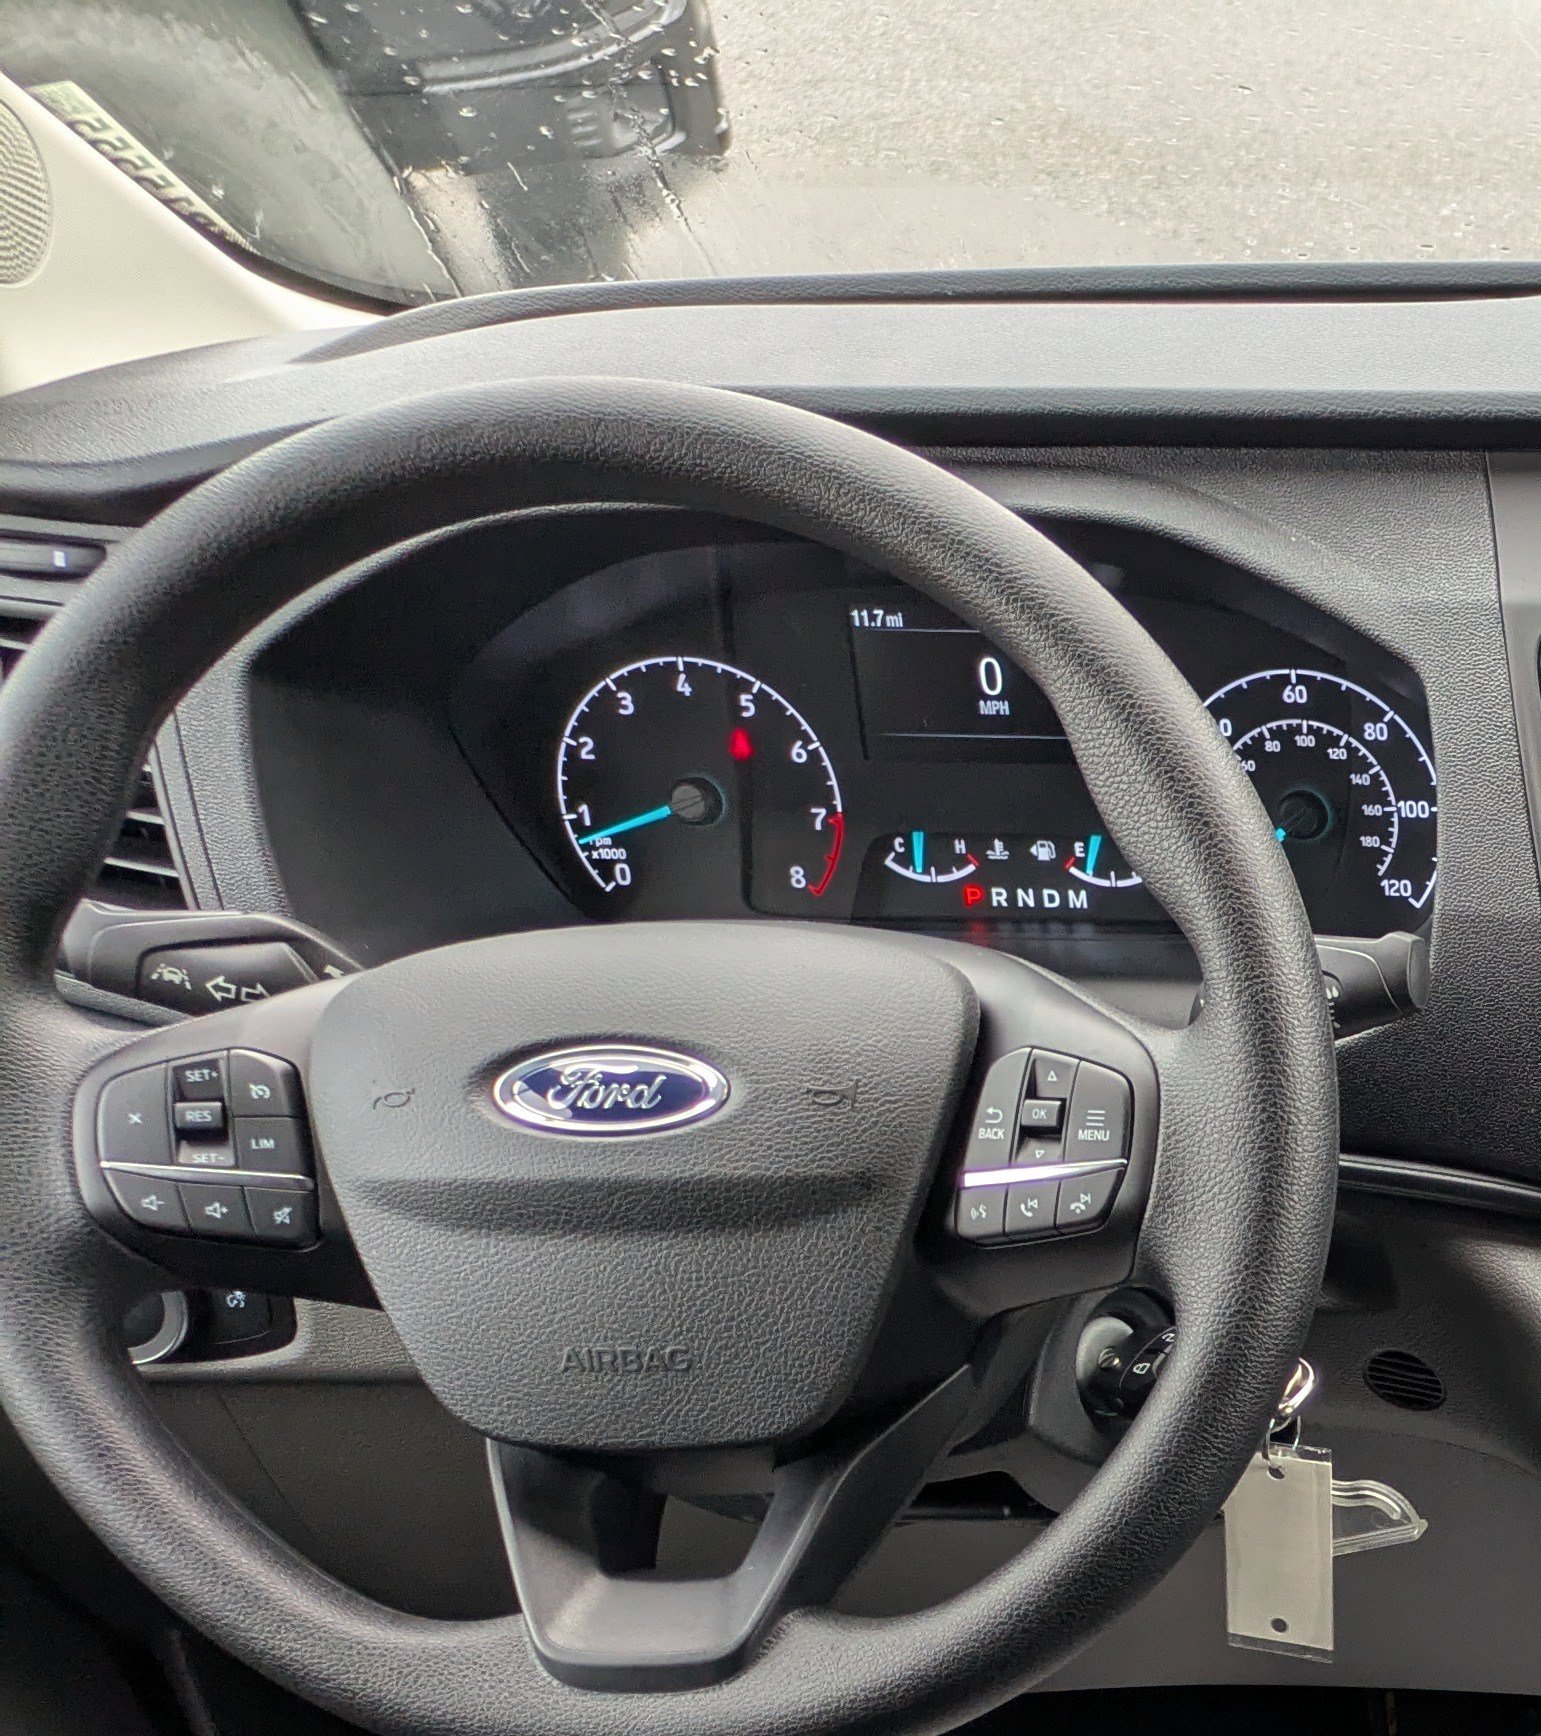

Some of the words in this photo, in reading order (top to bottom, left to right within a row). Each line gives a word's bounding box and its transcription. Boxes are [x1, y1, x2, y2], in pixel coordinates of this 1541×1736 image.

[850, 610, 883, 627] 11.7
[886, 612, 904, 628] mi
[978, 656, 1003, 696] 0
[676, 674, 692, 697] 4
[616, 691, 634, 715] 3
[1282, 685, 1308, 704] 60
[739, 695, 755, 717] 5
[978, 701, 1010, 716] MPH
[1364, 722, 1388, 741] 80
[578, 736, 596, 760] 2
[1265, 740, 1281, 753] 80
[1295, 735, 1316, 747] 100
[791, 741, 807, 763] 6
[1327, 748, 1348, 760] 120
[1349, 774, 1371, 786] 140
[578, 804, 591, 827] 1
[1361, 804, 1383, 816] 160
[1397, 800, 1429, 818] 100
[810, 807, 826, 830] 7
[893, 837, 905, 853] C
[954, 838, 967, 854] H
[1074, 842, 1085, 857] E
[1360, 836, 1381, 848] 180
[591, 848, 627, 860] x1000
[614, 863, 631, 886] 0
[789, 866, 807, 889] 8
[1380, 880, 1412, 897] 120
[964, 887, 983, 907] P
[991, 887, 1008, 907] R
[1016, 888, 1035, 908] N
[1042, 889, 1061, 908] D
[1068, 889, 1088, 909] M
[547, 1062, 667, 1110] Ford
[185, 1110, 213, 1123] RES
[1032, 1108, 1047, 1120] OK
[978, 1128, 1005, 1140] BACK
[1077, 1129, 1110, 1142] MENU
[251, 1138, 275, 1150] LIM
[561, 1346, 694, 1373] AIRBAG
